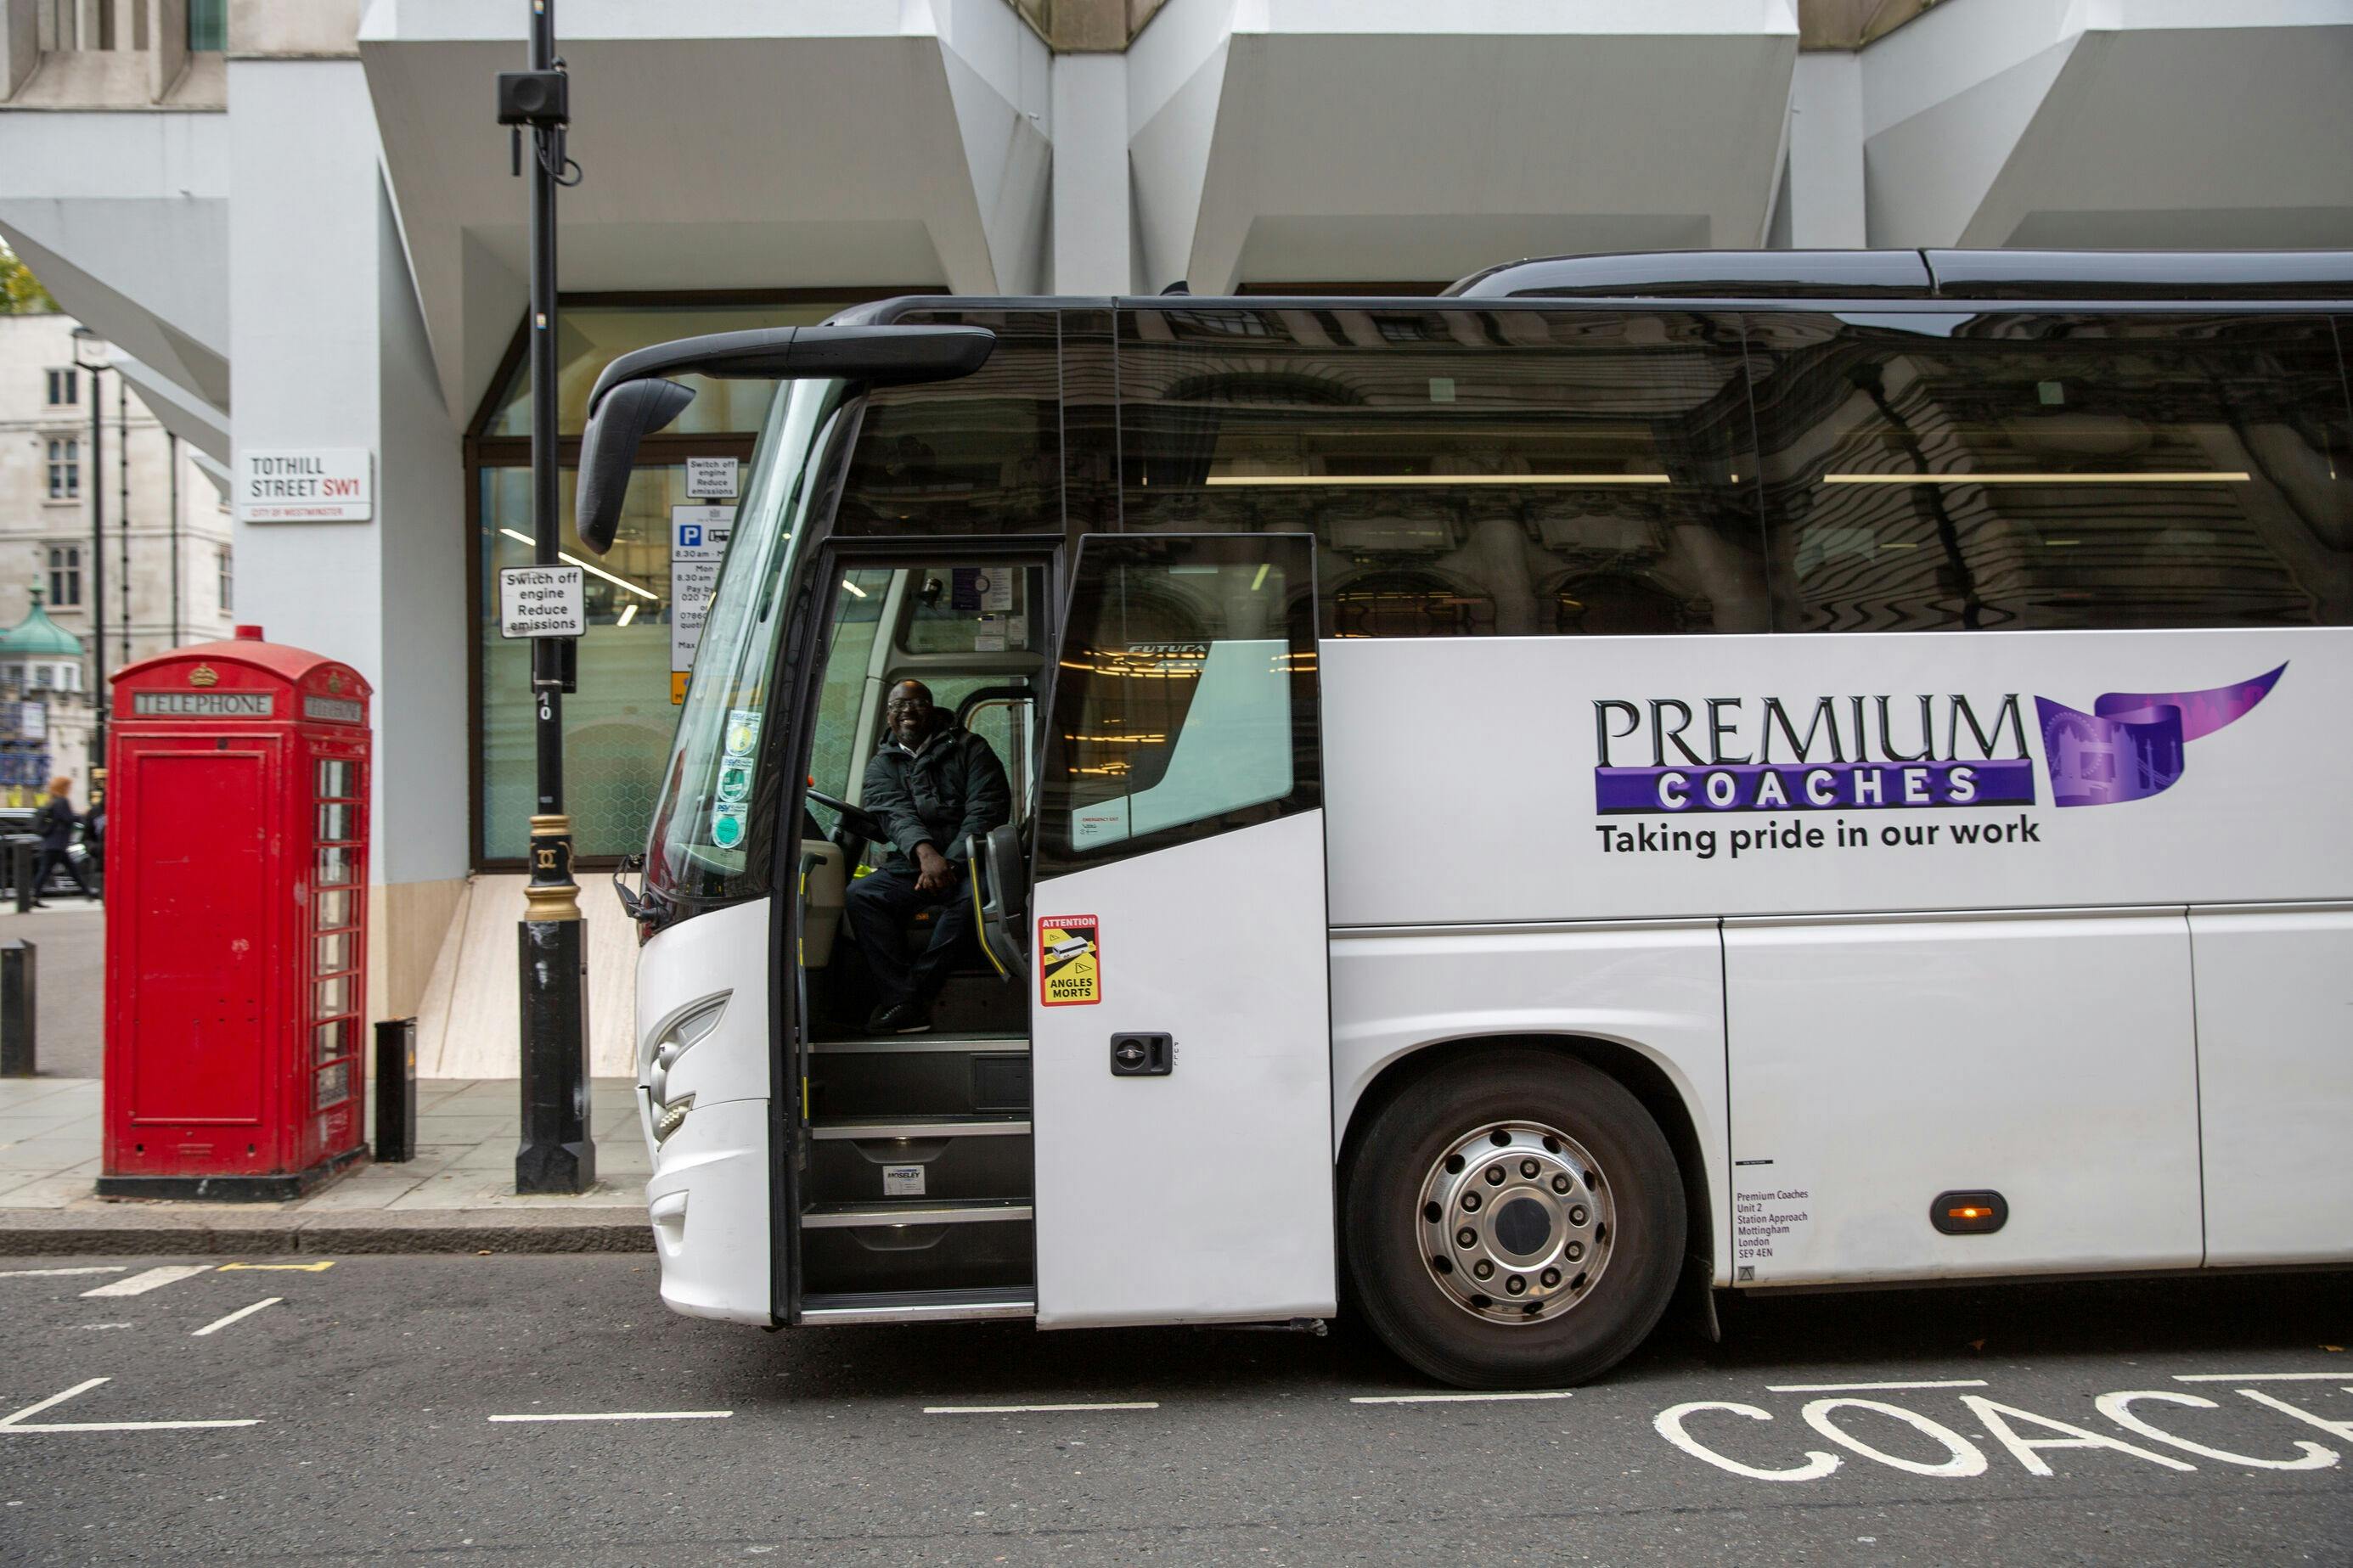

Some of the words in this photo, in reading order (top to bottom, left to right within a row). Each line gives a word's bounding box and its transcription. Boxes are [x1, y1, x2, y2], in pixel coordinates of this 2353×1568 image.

[251, 457, 324, 475] TOTHILL
[251, 479, 318, 497] STREET
[323, 478, 359, 496] SW1
[684, 527, 699, 545] P
[507, 574, 554, 586] Switch
[558, 572, 577, 584] off
[520, 588, 565, 601] engine
[518, 605, 568, 615] Reduce
[510, 620, 577, 631] emissions
[142, 694, 269, 715] TELEPHONE
[1591, 694, 2033, 768] PREMIUM
[1654, 767, 1980, 810] COACHES
[1596, 823, 1717, 859] Taking
[1730, 819, 1826, 857] pride
[1837, 818, 1869, 847] in
[1880, 823, 1940, 846] our
[1950, 814, 2040, 846] work
[1043, 919, 1095, 928] ATTENTION
[1050, 978, 1093, 988] ANGLES
[1053, 988, 1091, 998] MORTS
[1737, 1192, 1776, 1201] Premium
[1776, 1189, 1809, 1200] Coaches
[1737, 1204, 1755, 1212] Unit
[1757, 1203, 1762, 1211] 2
[1737, 1215, 1767, 1224] Station
[1769, 1212, 1808, 1224] Approach
[1738, 1226, 1790, 1237] Mottingham
[1738, 1238, 1770, 1246] London
[1739, 1250, 1754, 1258] SE9
[1756, 1248, 1773, 1256] 4EN
